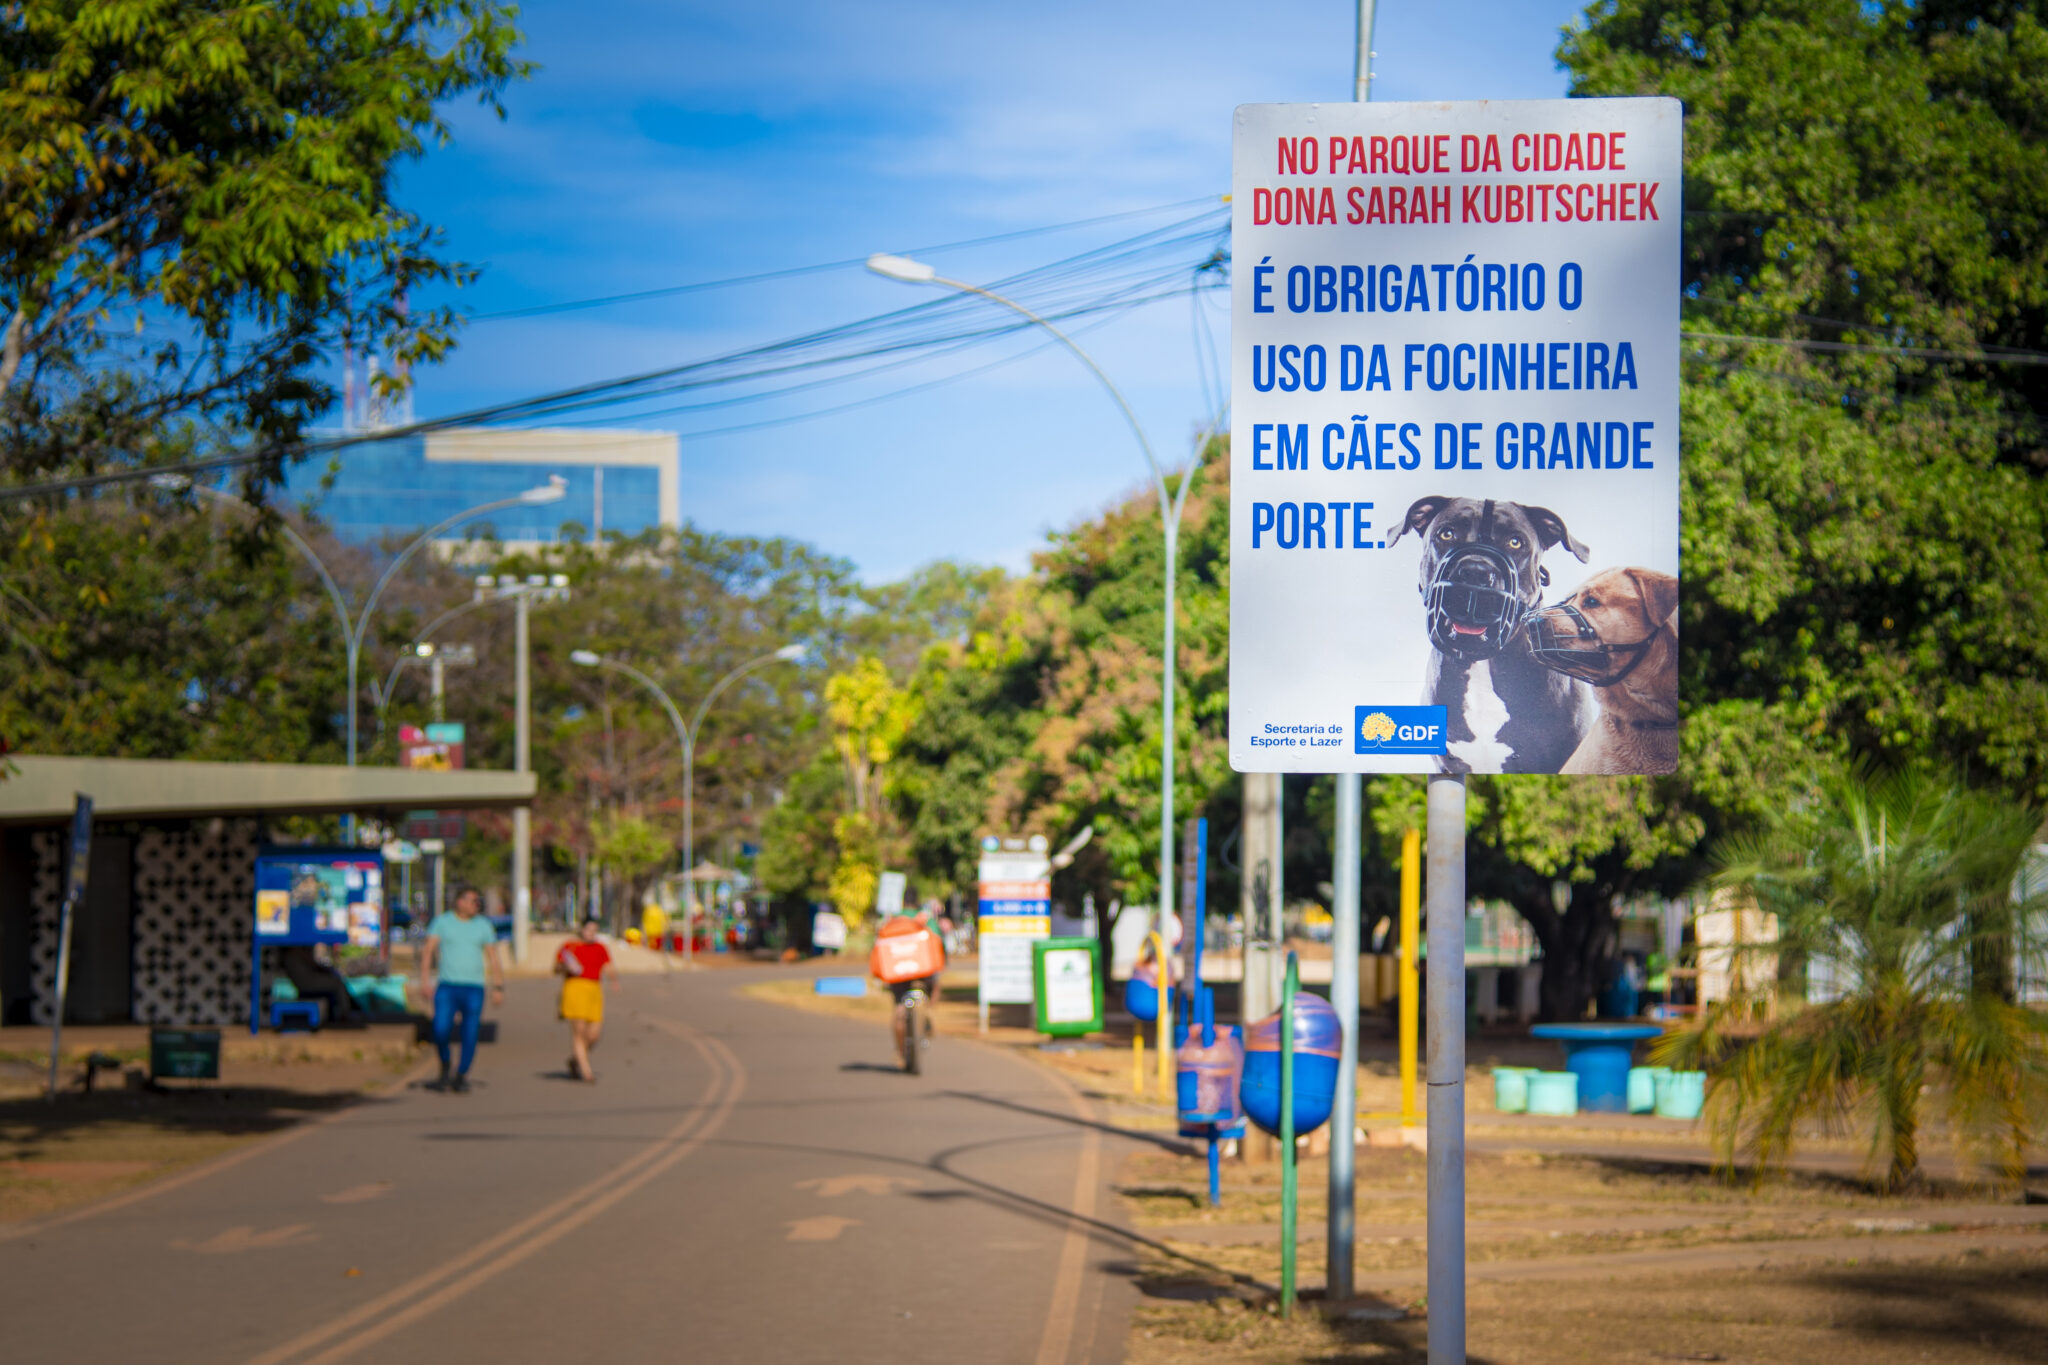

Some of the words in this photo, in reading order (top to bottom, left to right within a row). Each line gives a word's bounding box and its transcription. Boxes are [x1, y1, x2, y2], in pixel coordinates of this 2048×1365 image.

[1277, 136, 1319, 175] NO
[1329, 135, 1451, 175] PARQUE
[1460, 134, 1503, 173] DA
[1511, 132, 1627, 173] CIDADE
[1253, 187, 1338, 226] DONA
[1346, 186, 1451, 225] SARAH
[1461, 182, 1660, 224] KUBITSCHEK
[1253, 256, 1275, 314] É
[1287, 254, 1546, 314] OBRIGATÓRIO
[1558, 262, 1583, 312] O
[1252, 344, 1327, 392] USO
[1340, 344, 1392, 392] DA
[1403, 341, 1639, 392] FOCINHEIRA
[1252, 423, 1309, 471] EM
[1321, 414, 1422, 471] CÃES
[1433, 422, 1483, 471] DE
[1495, 421, 1655, 470] GRANDE
[1252, 501, 1386, 550] PORTE.
[1250, 736, 1296, 748] Esporte
[1299, 738, 1307, 747] e
[1310, 736, 1343, 747] Lazer
[1264, 723, 1325, 734] Secretaria
[1328, 723, 1343, 734] de
[1398, 725, 1440, 741] GDF
